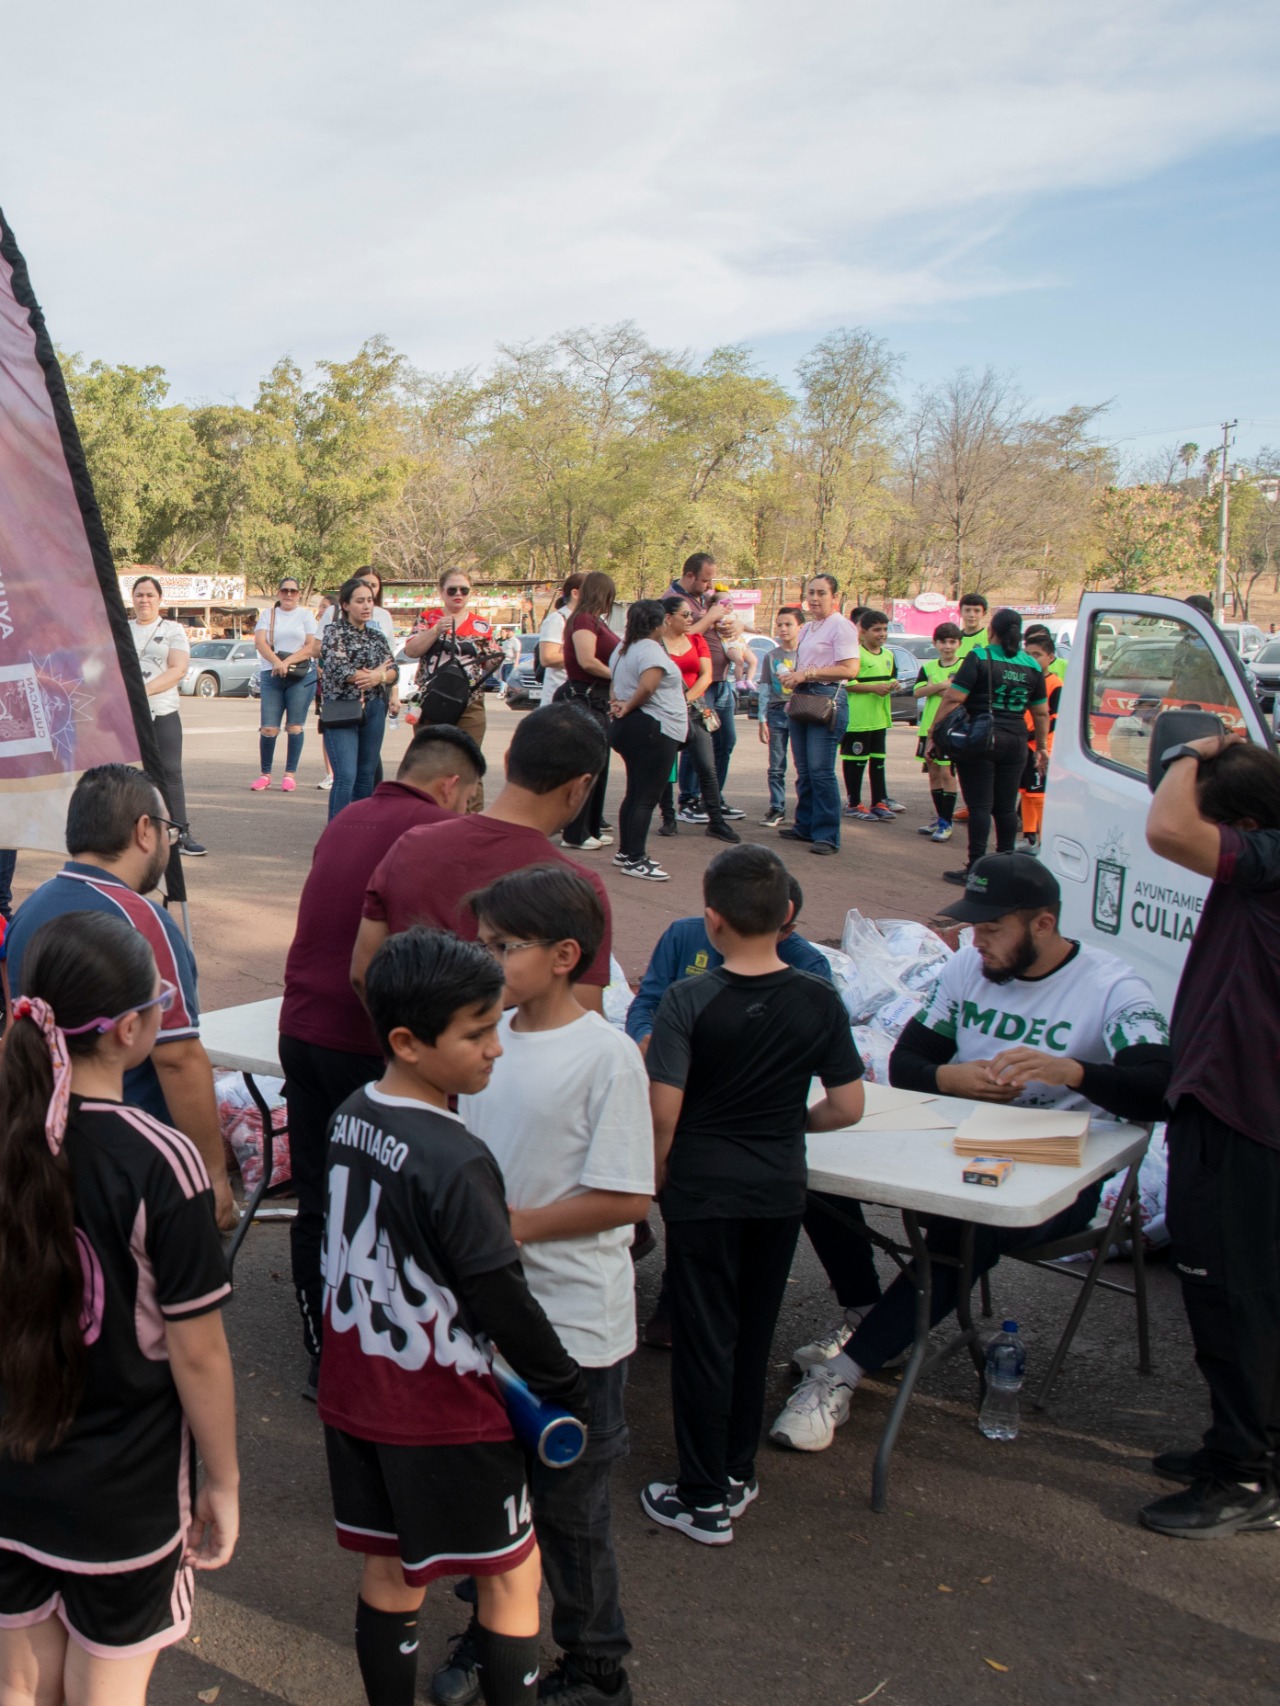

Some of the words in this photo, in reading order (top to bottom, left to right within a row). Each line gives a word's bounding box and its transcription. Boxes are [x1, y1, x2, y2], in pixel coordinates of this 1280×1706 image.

[1134, 881, 1203, 913] AYUNTAMIE
[1131, 901, 1195, 942] CULIA
[962, 1000, 1072, 1051] MDEC
